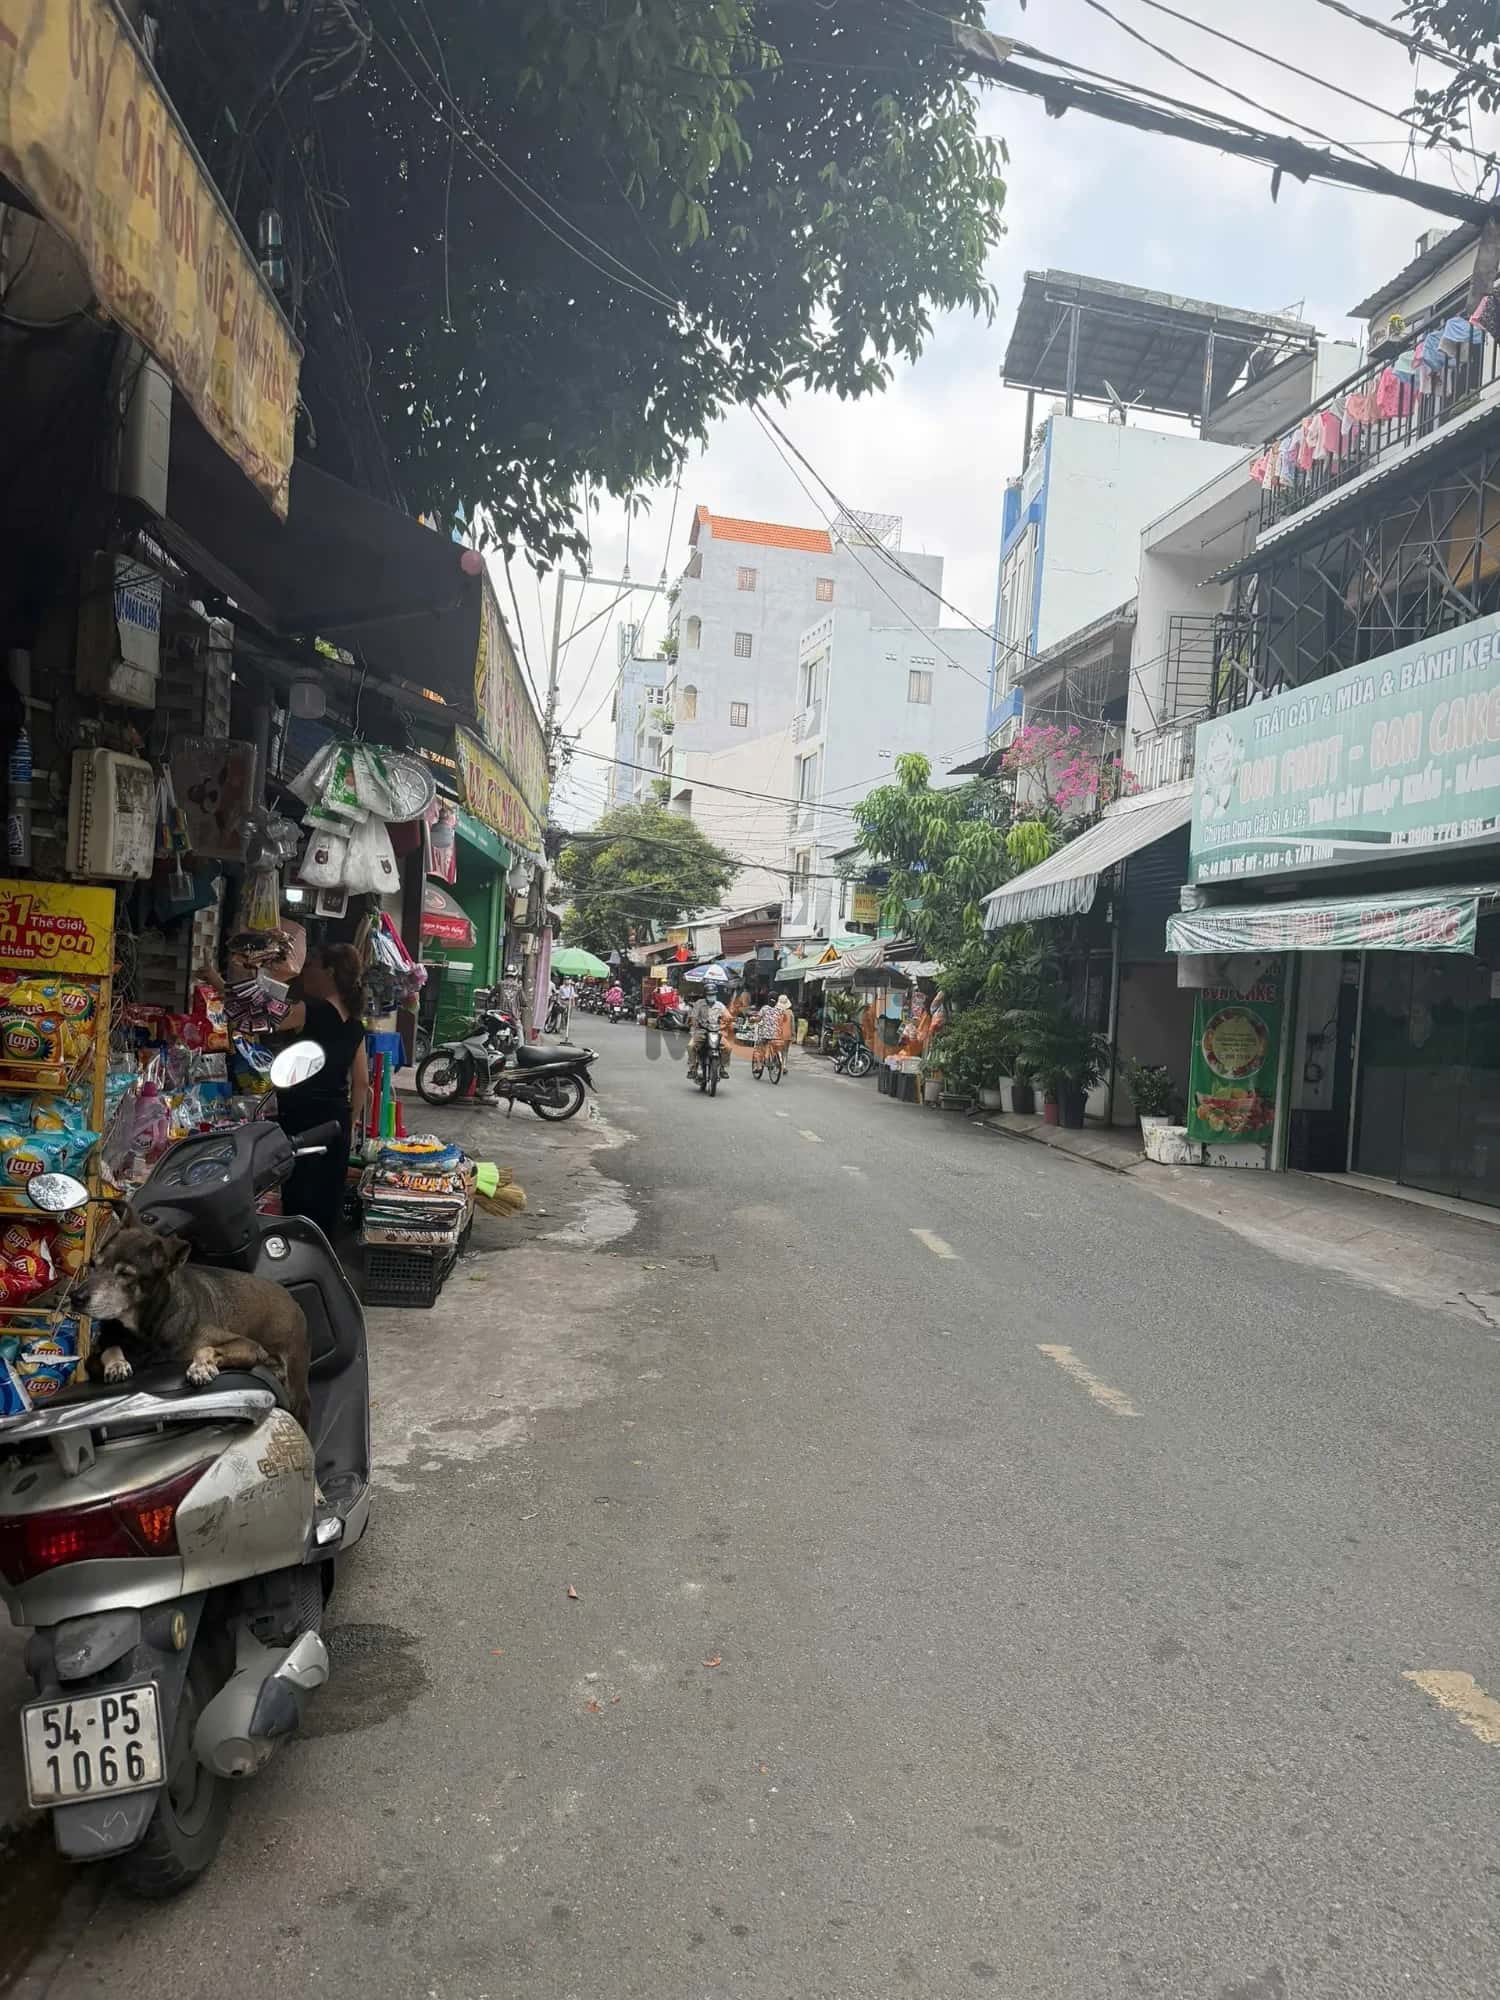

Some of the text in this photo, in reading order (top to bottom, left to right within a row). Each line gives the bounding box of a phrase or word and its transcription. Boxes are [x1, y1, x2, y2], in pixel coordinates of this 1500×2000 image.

[1254, 709, 1286, 740] TRÁI
[1288, 696, 1318, 728] CÂY
[1320, 694, 1331, 719] 4
[1335, 677, 1377, 713] MÙA
[1380, 670, 1395, 697] &
[1400, 649, 1457, 691] BÁNH
[30, 916, 55, 928] Thế
[26, 930, 93, 956] ngon
[8, 1033, 39, 1050] Lay's
[8, 1158, 43, 1176] Lay's
[7, 1230, 31, 1248] Lay's
[27, 1379, 58, 1393] Lay's
[46, 1740, 145, 1795] 1066
